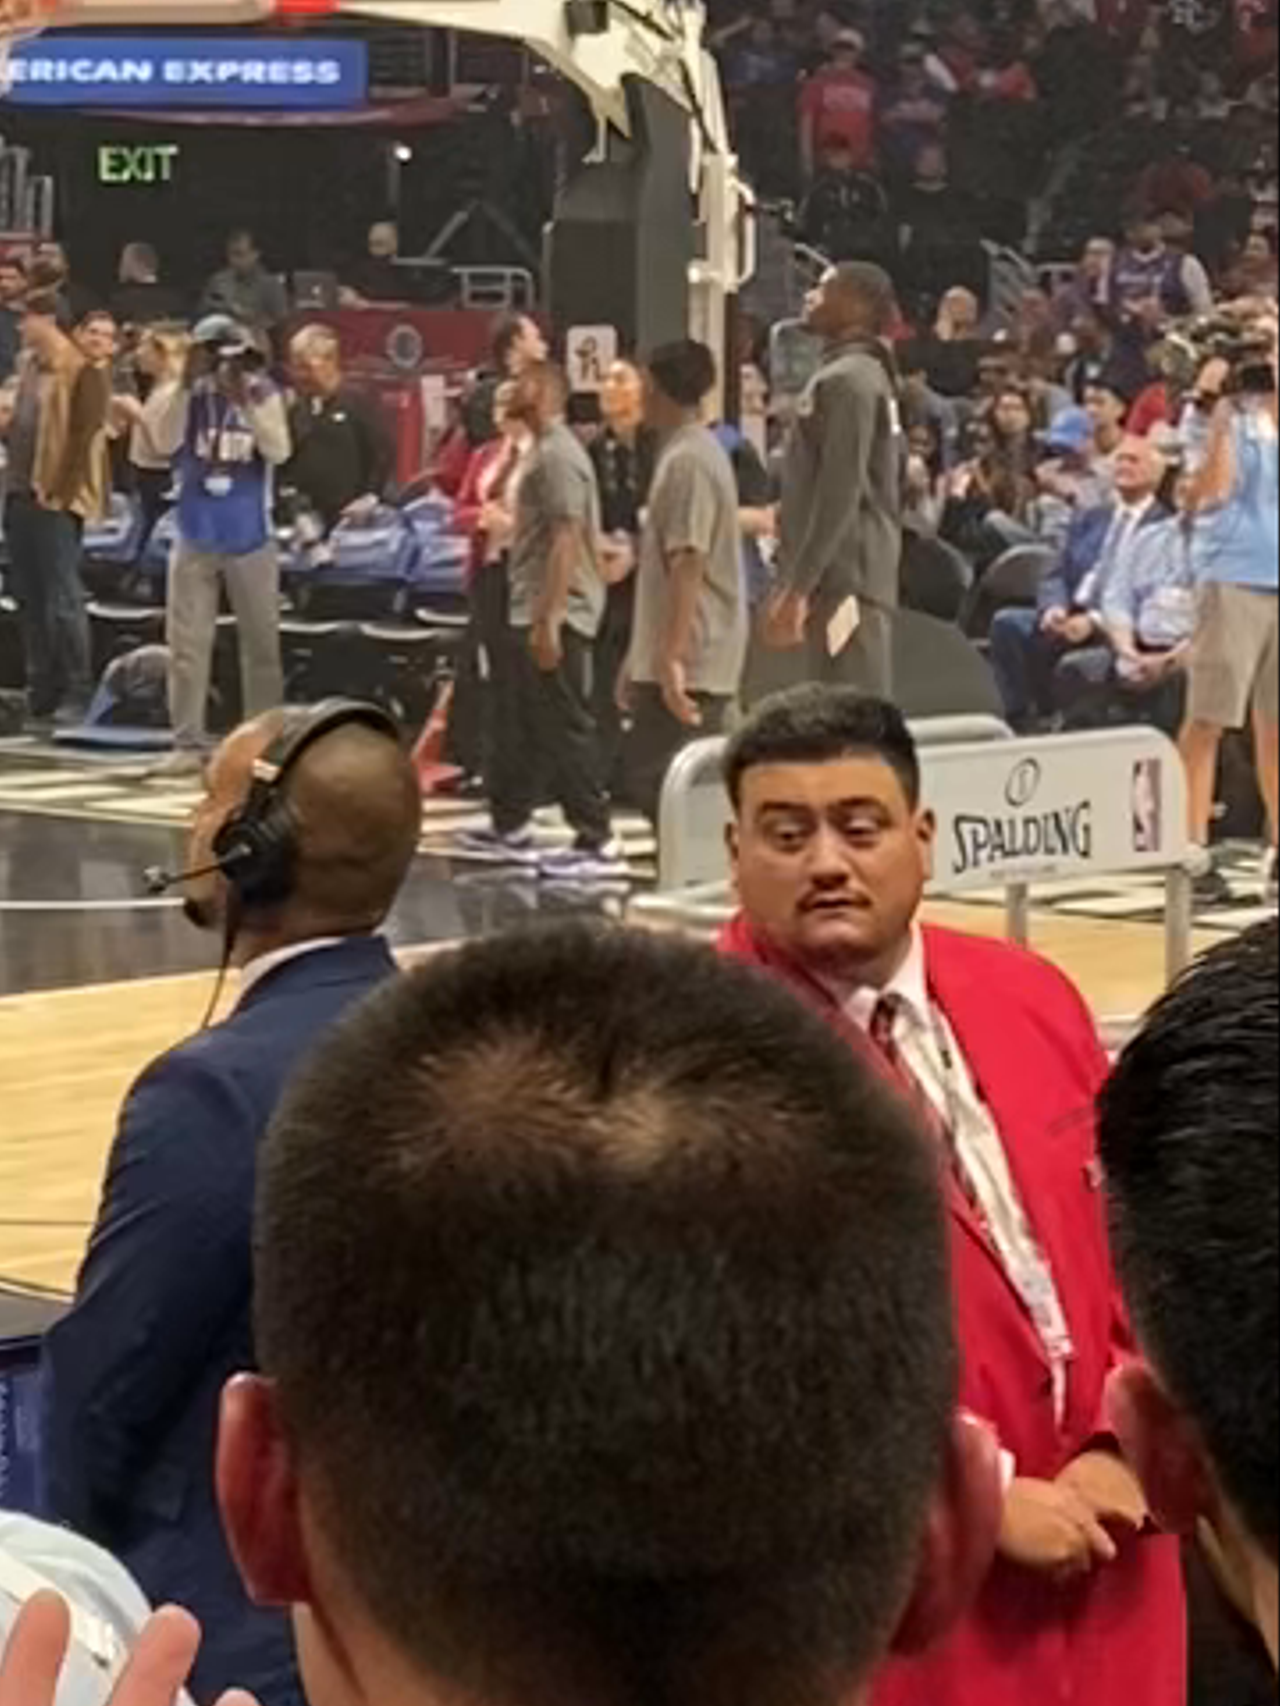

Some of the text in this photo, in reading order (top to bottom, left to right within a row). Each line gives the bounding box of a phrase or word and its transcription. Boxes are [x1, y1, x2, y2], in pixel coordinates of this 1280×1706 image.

[4, 58, 341, 85] ERICAN EXPRESS
[97, 145, 180, 183] EXIT
[952, 798, 1091, 874] SPALDING
